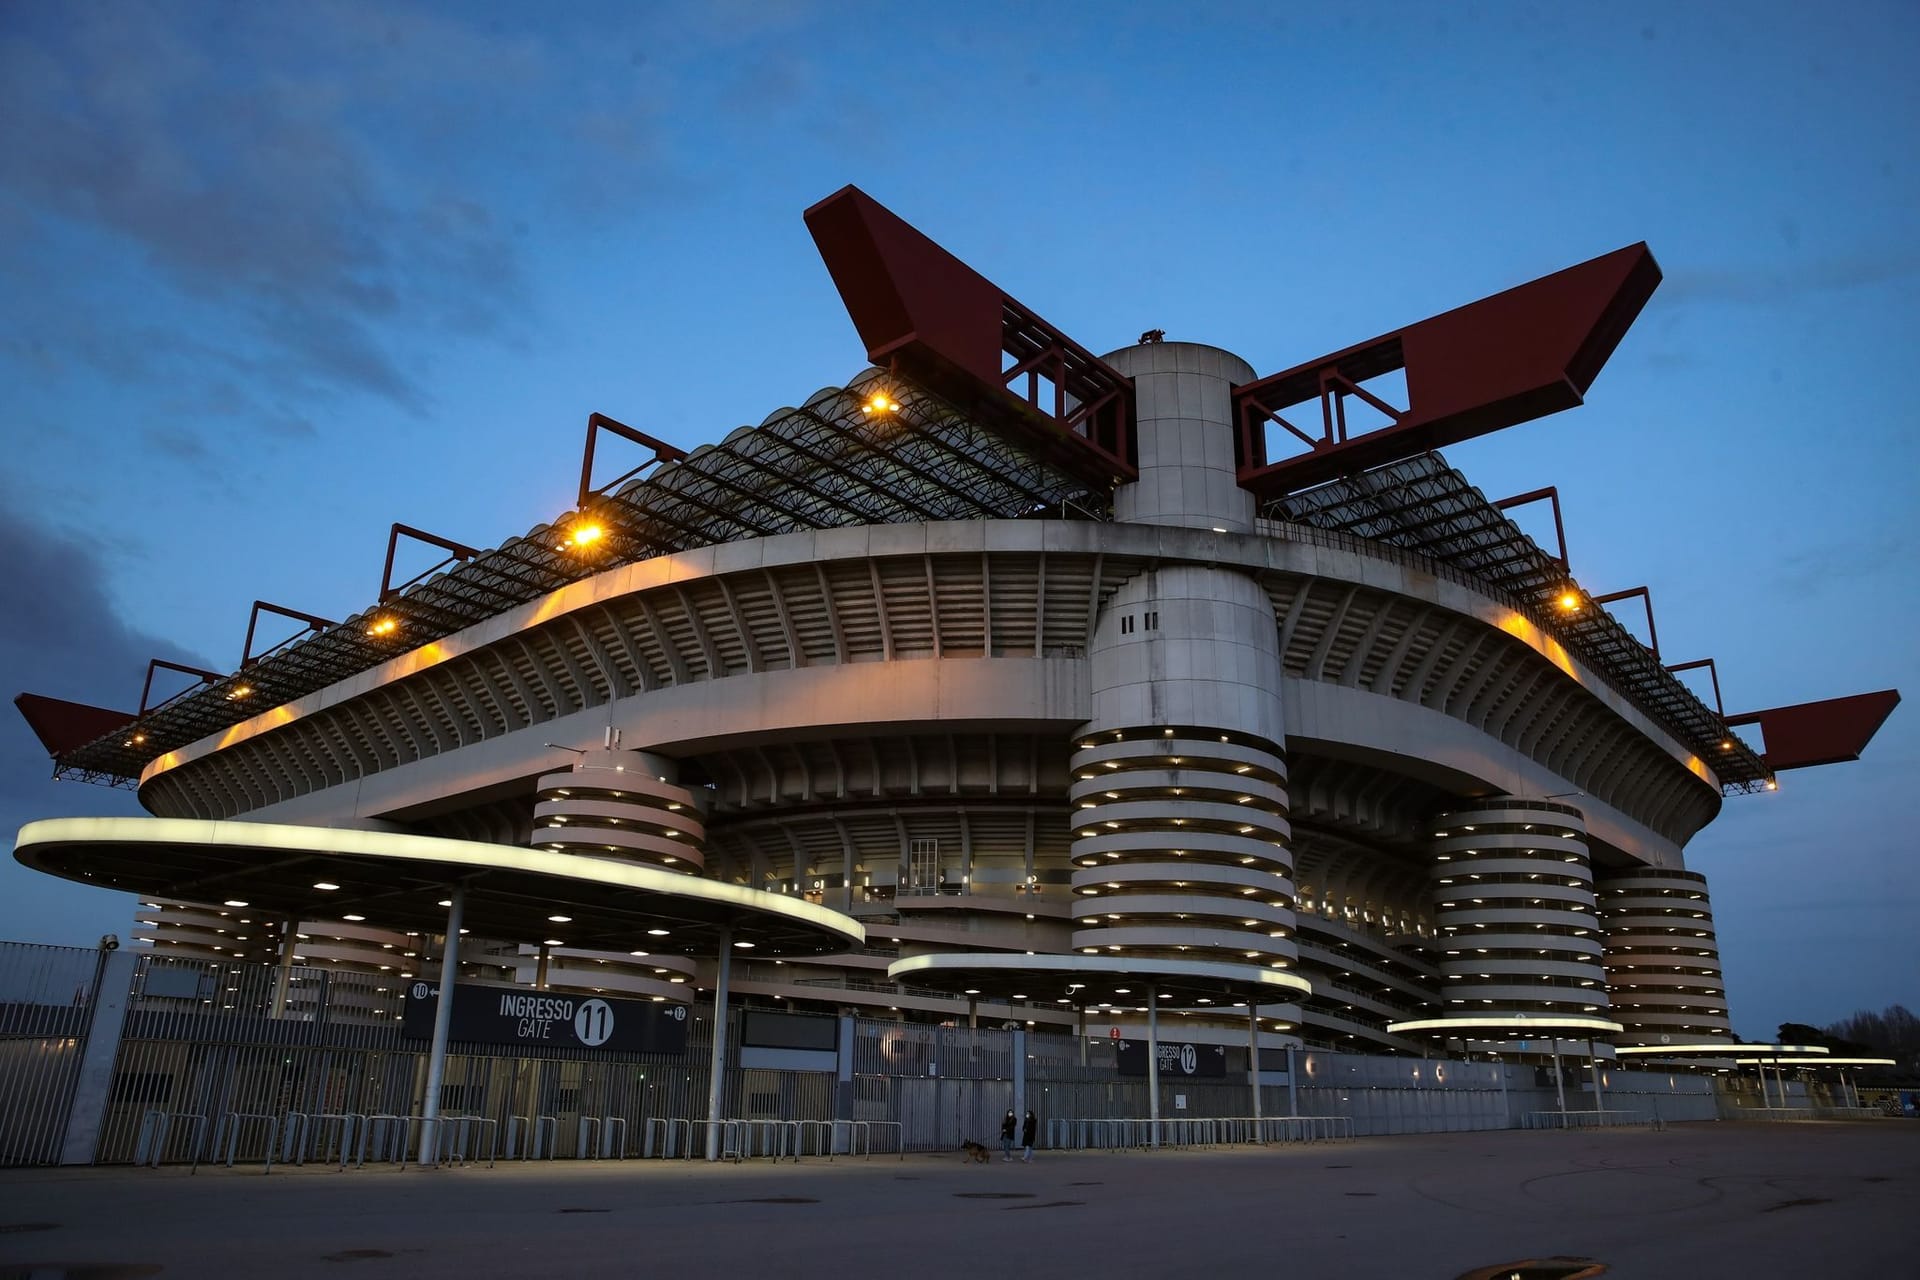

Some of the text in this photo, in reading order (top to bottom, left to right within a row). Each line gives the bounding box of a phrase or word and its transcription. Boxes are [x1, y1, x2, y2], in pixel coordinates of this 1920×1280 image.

[499, 994, 573, 1021] INGRESSO
[517, 1018, 553, 1039] GATE
[582, 1004, 607, 1040] 11
[1182, 1047, 1194, 1070] 12
